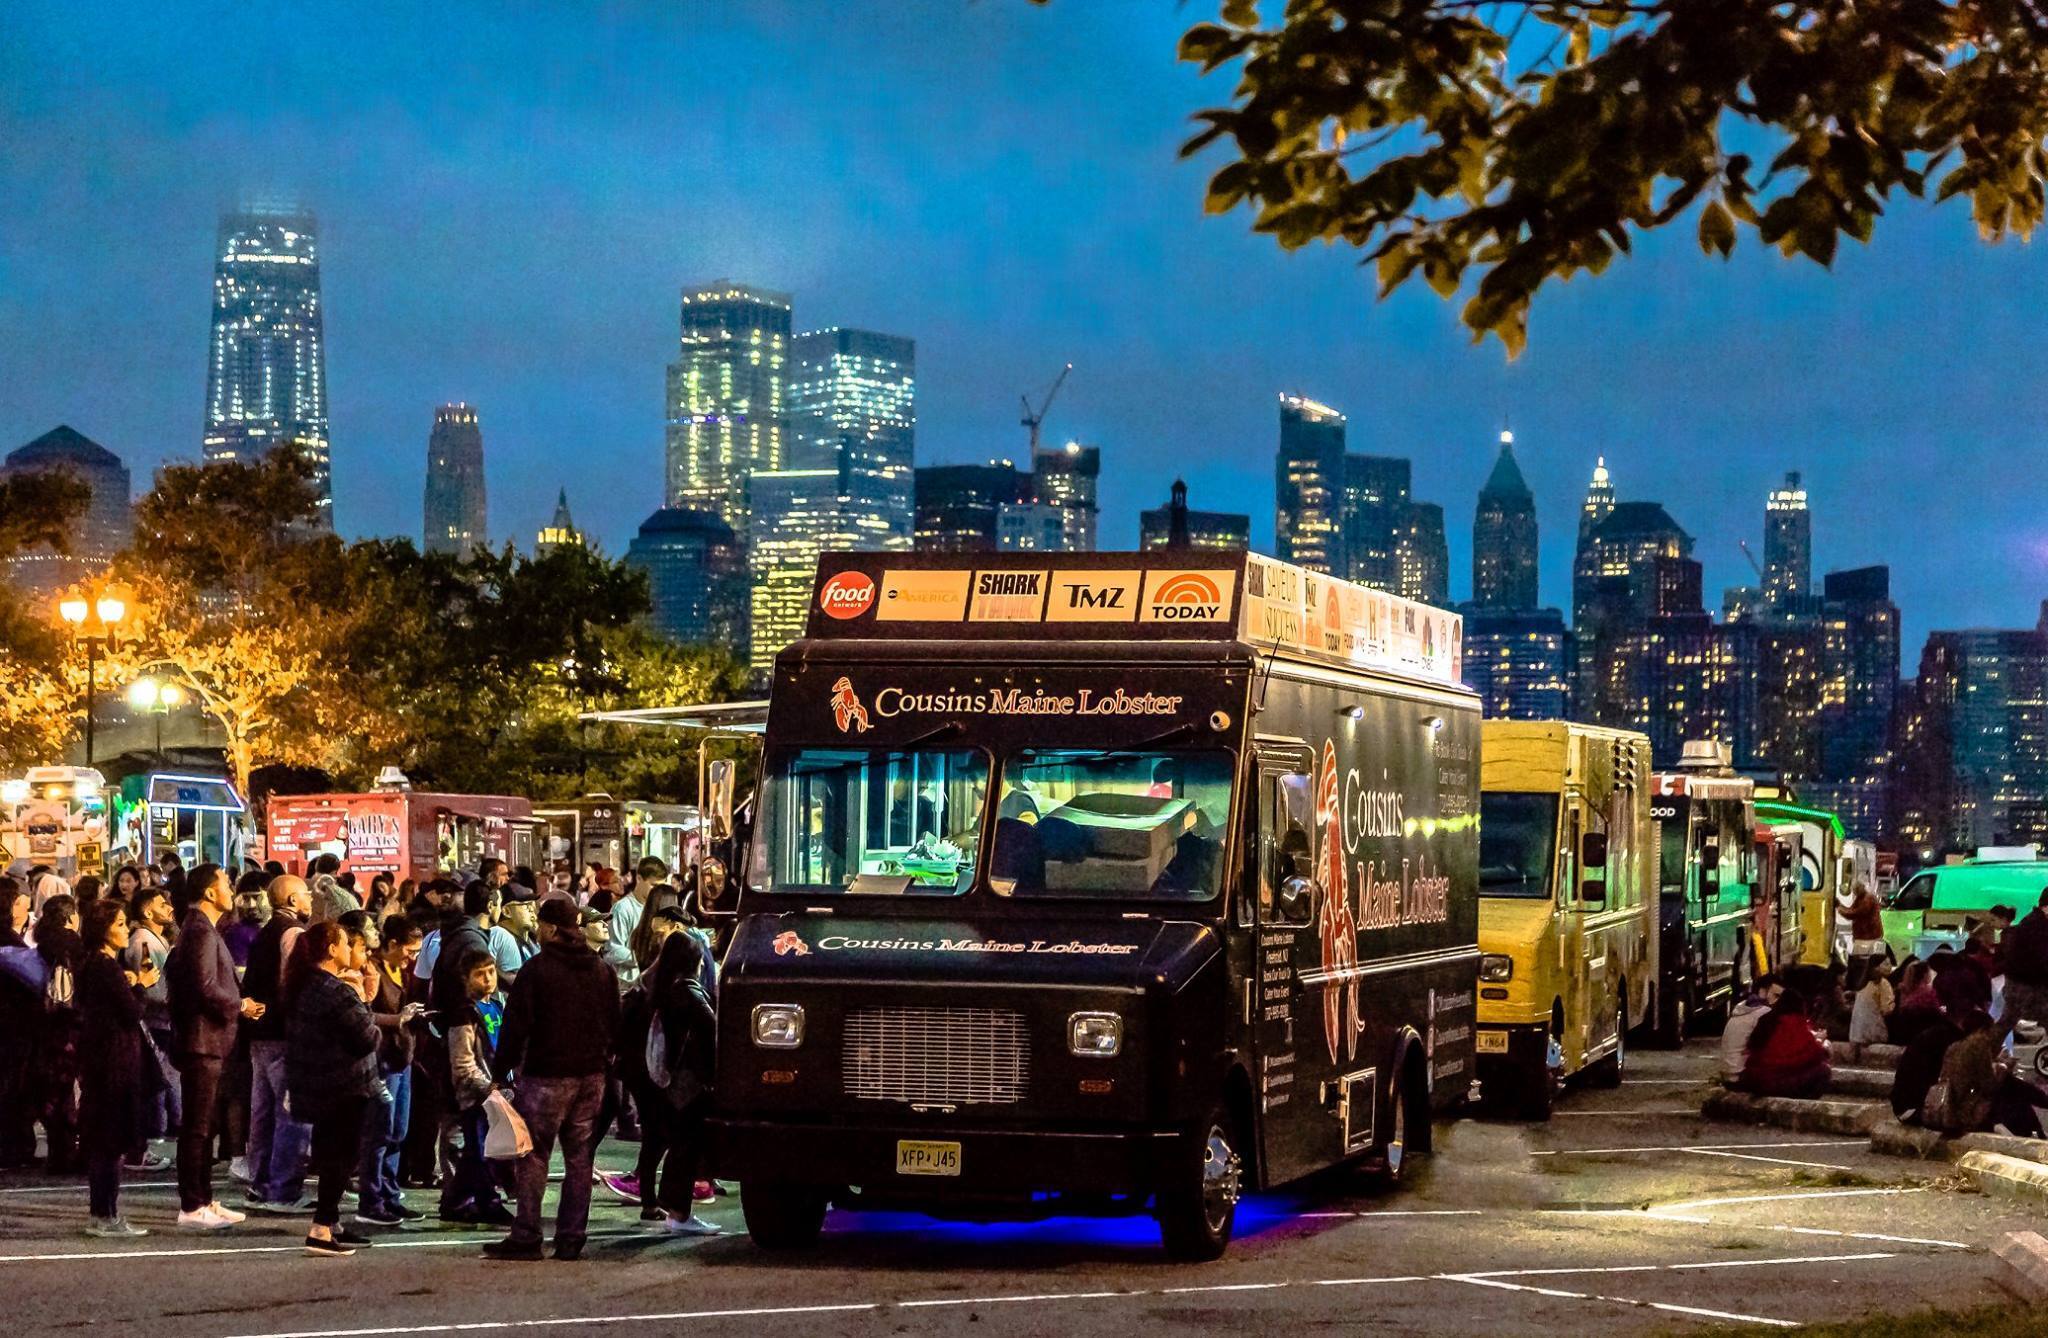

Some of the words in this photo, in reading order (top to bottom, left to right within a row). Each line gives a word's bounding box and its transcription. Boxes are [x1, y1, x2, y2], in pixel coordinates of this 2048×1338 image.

[821, 582, 874, 609] food
[979, 574, 1041, 595] SHARK
[1267, 564, 1297, 603] SAVEUR
[1063, 584, 1125, 609] TMZ
[1152, 605, 1221, 620] TODAY
[1325, 632, 1341, 652] TODAY
[875, 687, 986, 717] Cousins
[988, 688, 1075, 715] Maine
[1076, 687, 1183, 715] Lobster
[1344, 768, 1404, 854] Cousins
[1650, 807, 1676, 817] OOD
[1357, 860, 1401, 931] Maine
[1402, 854, 1450, 925] Lobster
[817, 935, 934, 952] Cousins
[935, 937, 1026, 954] Maine
[1026, 938, 1139, 955] Lobster
[902, 1150, 924, 1167] XFP
[933, 1150, 956, 1168] J45
